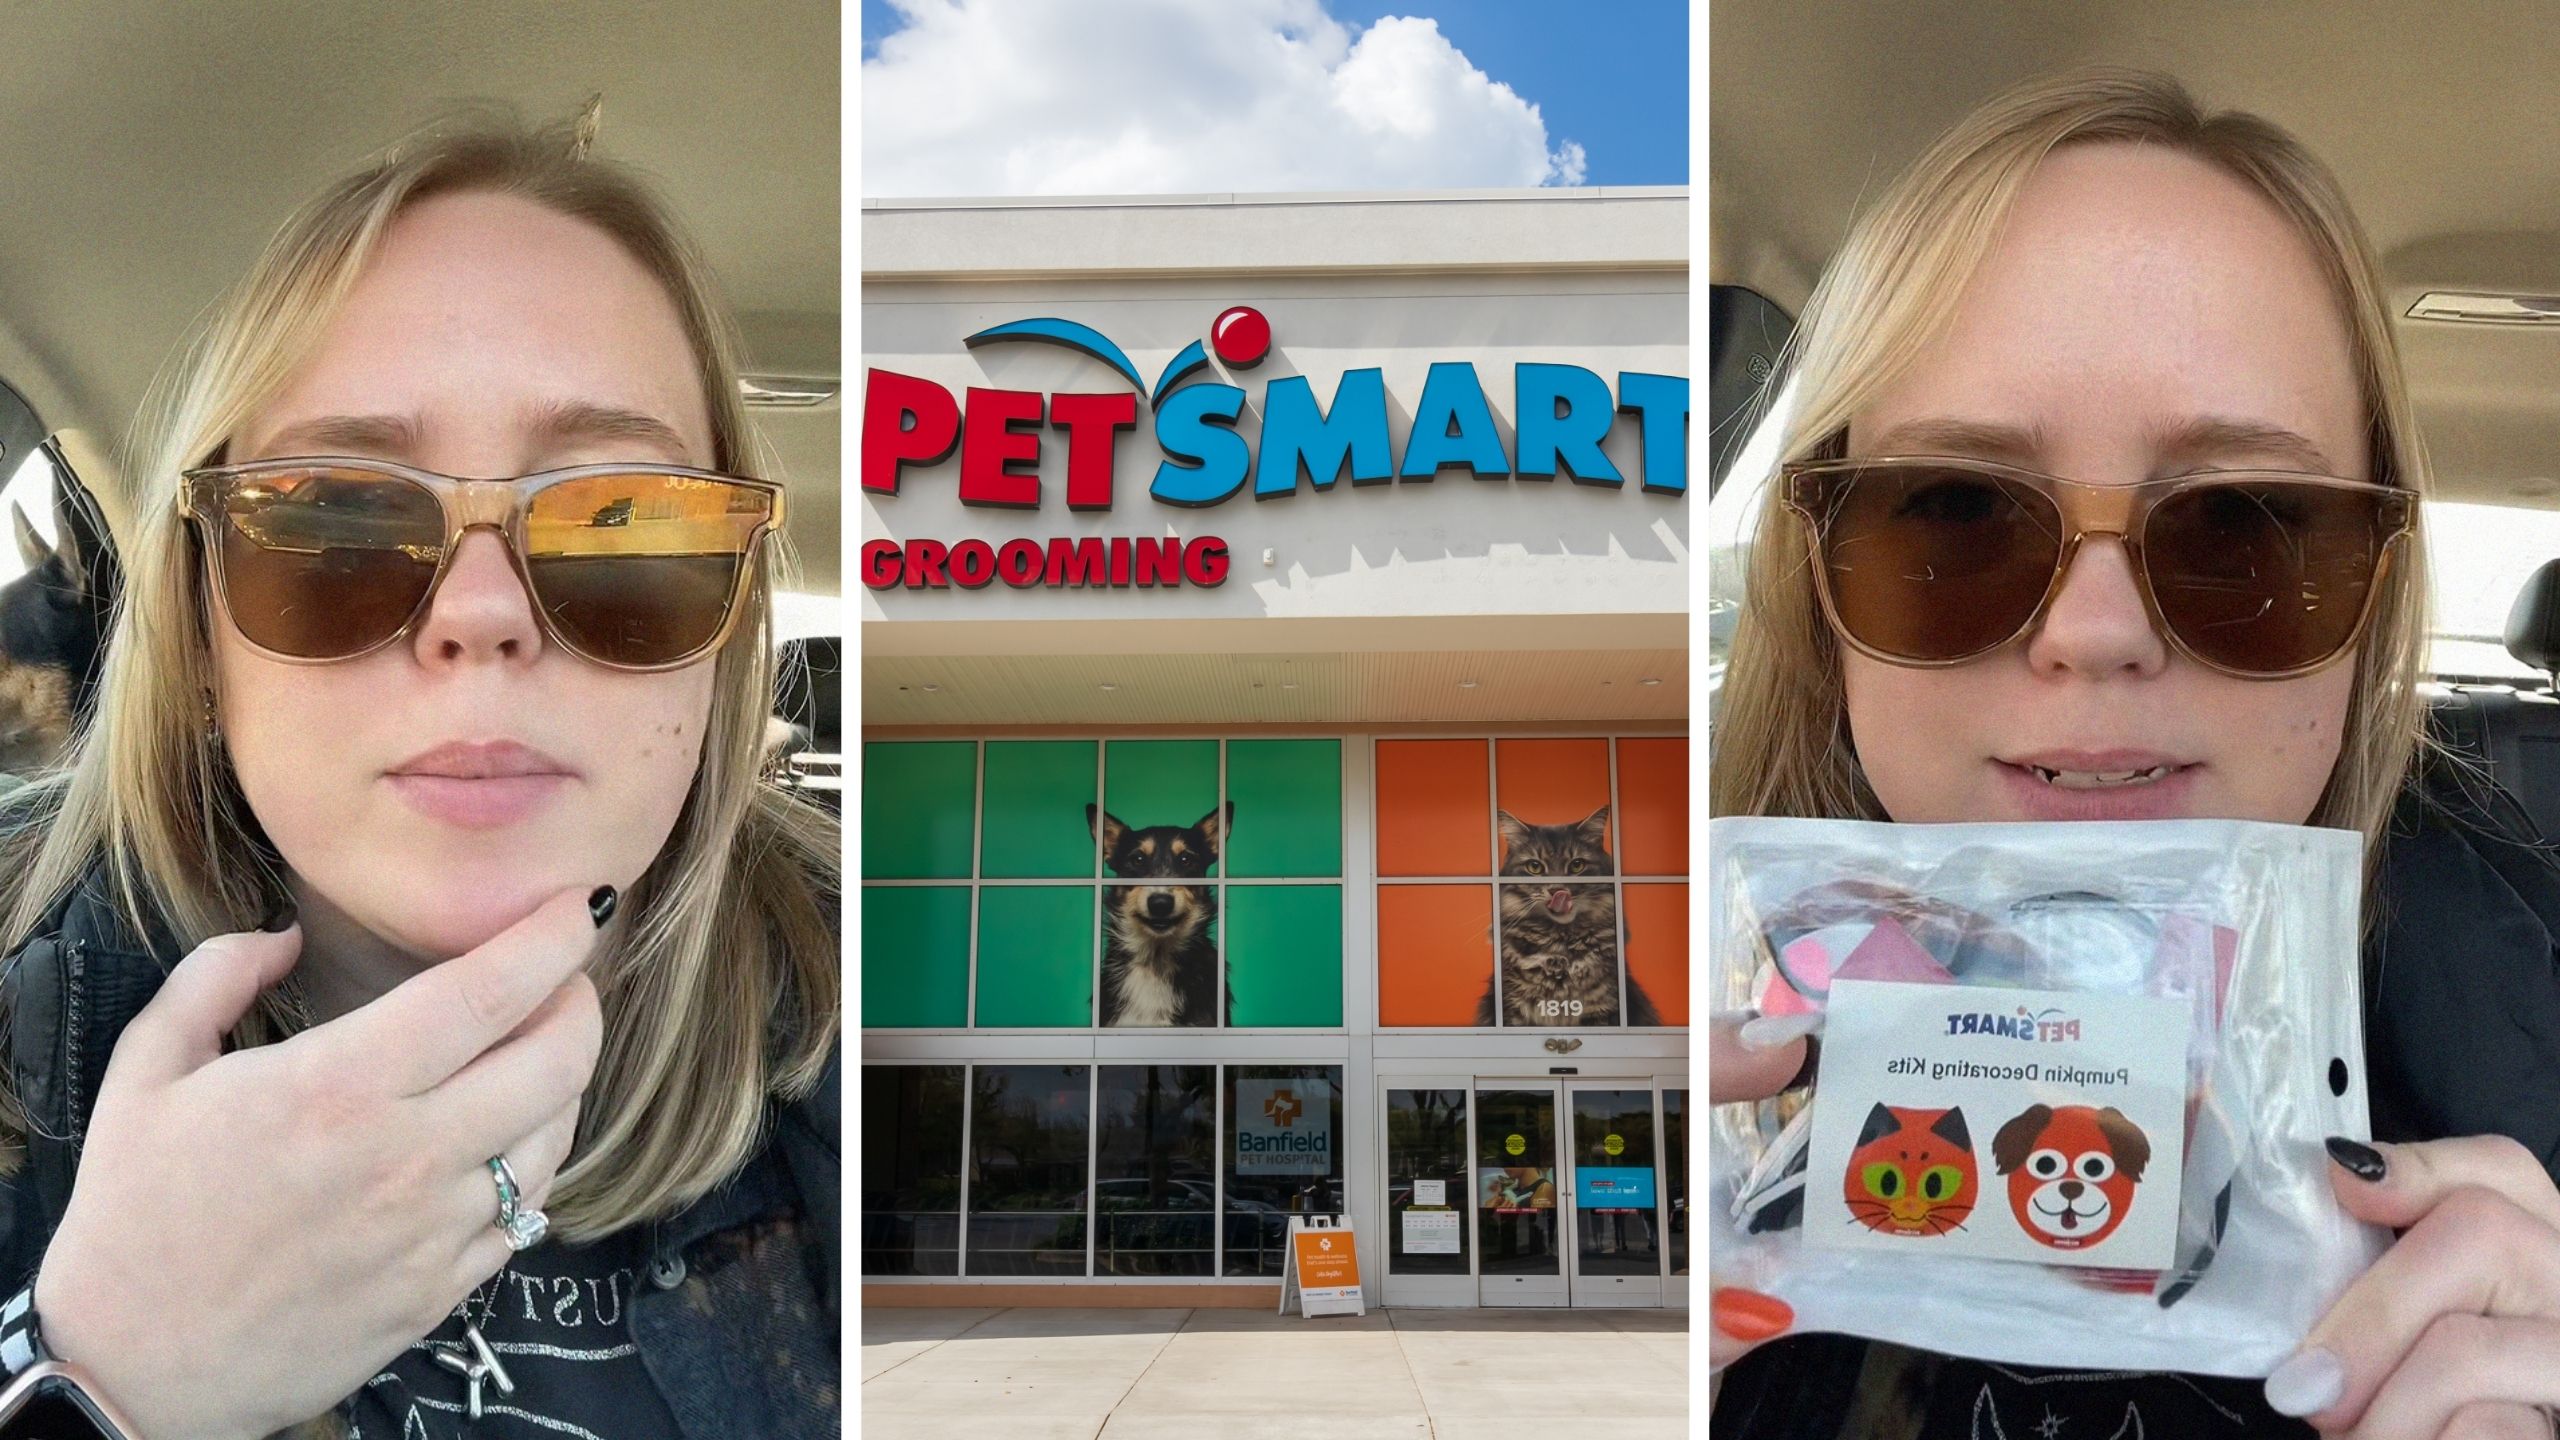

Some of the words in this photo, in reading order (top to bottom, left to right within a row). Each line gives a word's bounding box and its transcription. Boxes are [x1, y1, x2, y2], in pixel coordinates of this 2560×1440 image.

[861, 536, 1230, 592] GROOMING
[1537, 1000, 1583, 1016] 1819
[1239, 1131, 1327, 1152] Banfield
[1241, 1154, 1263, 1165] PET
[1266, 1154, 1326, 1165] HOSPITAL
